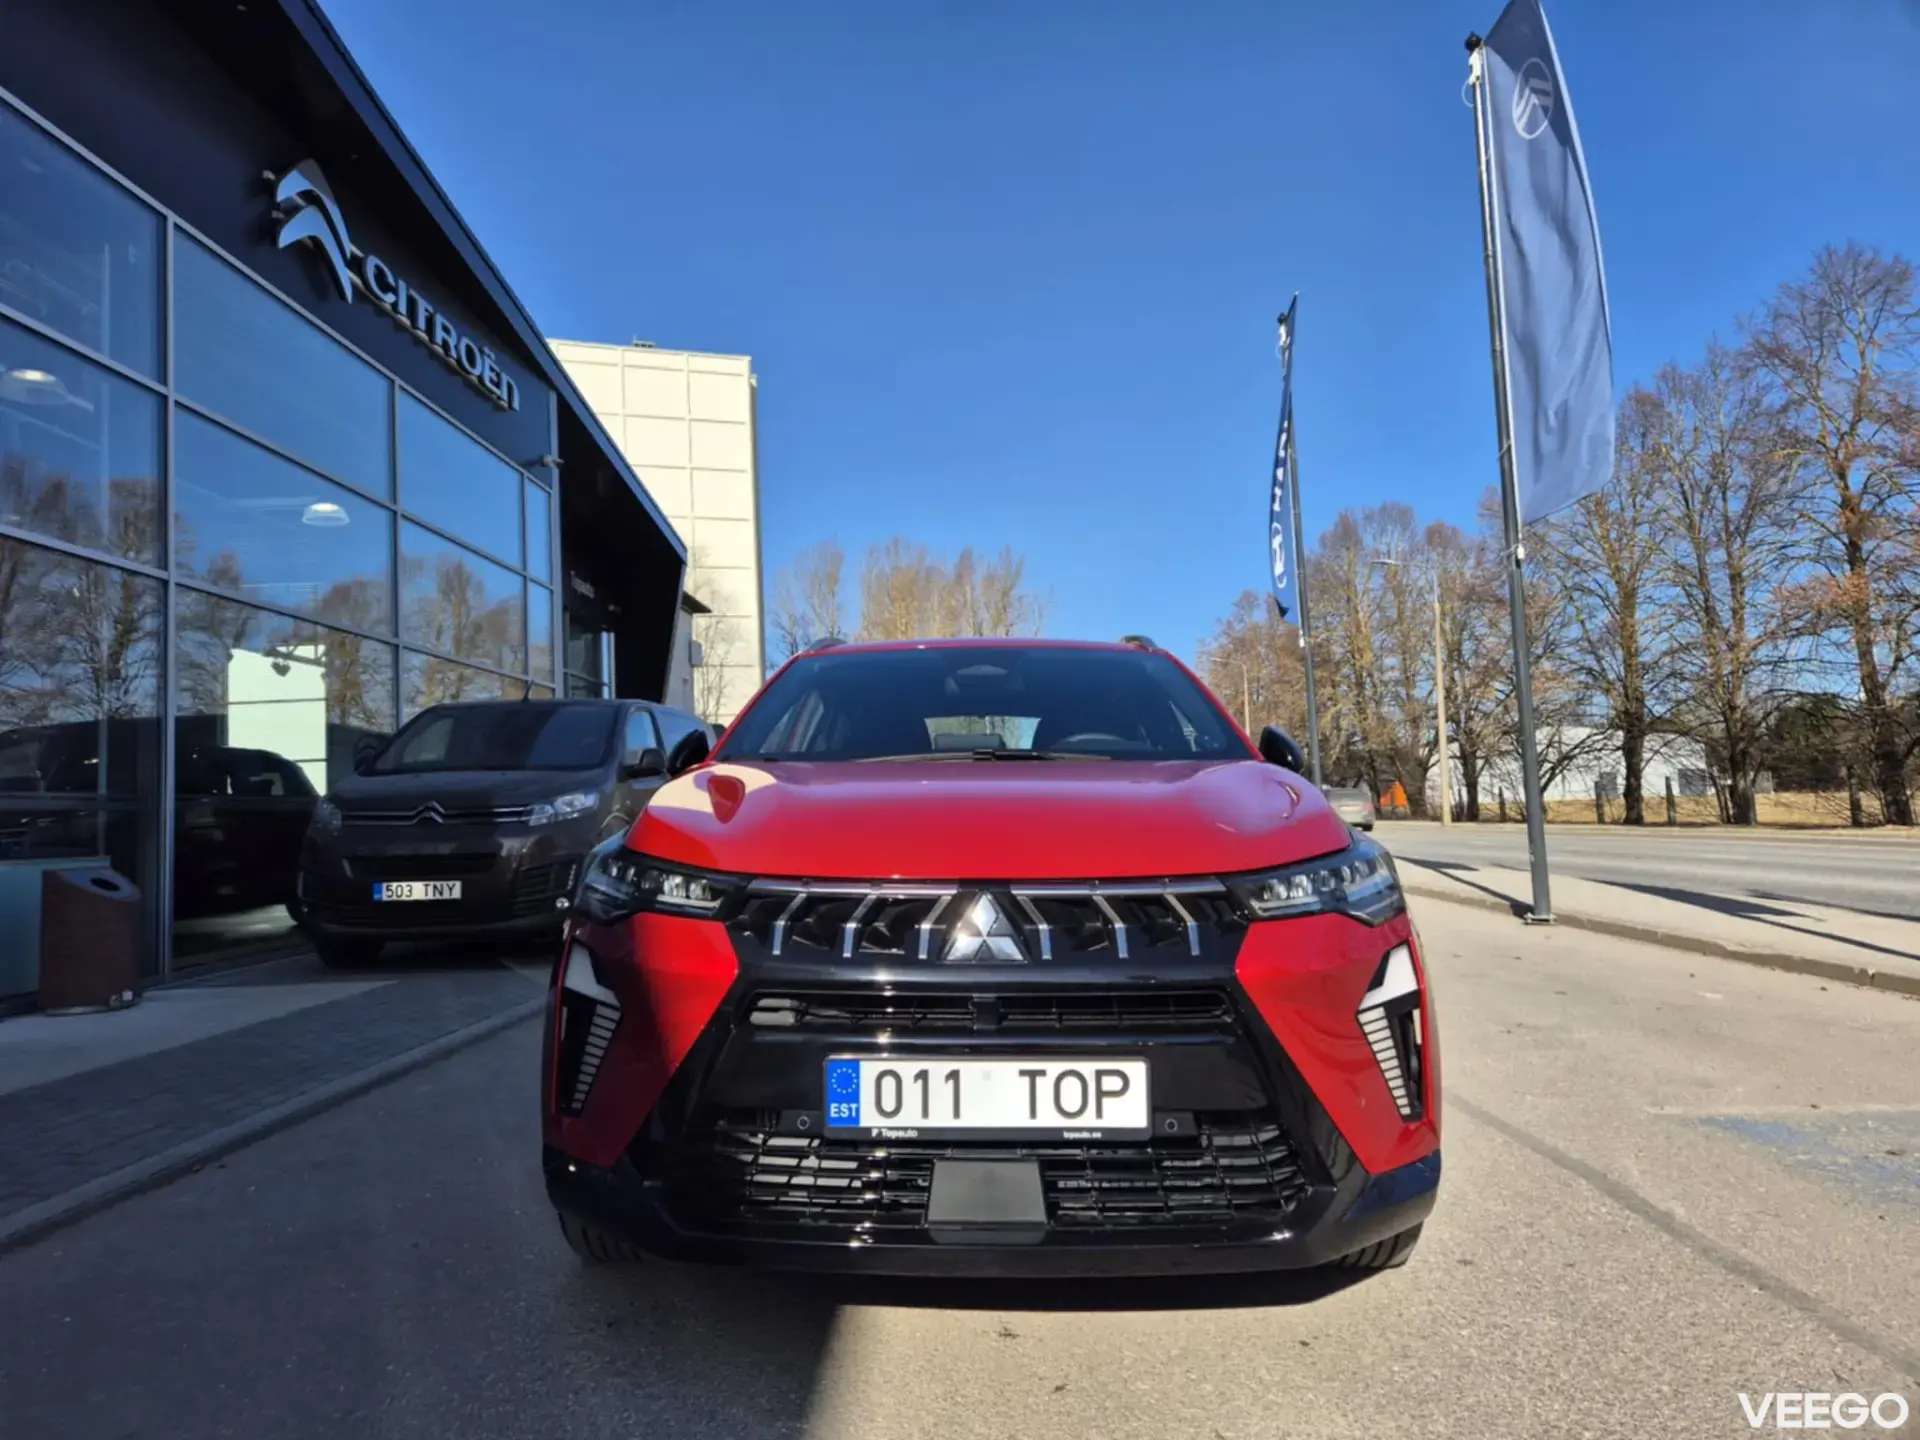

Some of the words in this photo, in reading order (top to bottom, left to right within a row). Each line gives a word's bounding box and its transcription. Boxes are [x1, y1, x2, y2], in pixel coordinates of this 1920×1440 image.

[385, 884, 413, 899] 503
[422, 882, 457, 898] TNY
[874, 1069, 961, 1119] 011
[1018, 1069, 1130, 1120] TOP
[830, 1102, 859, 1118] EST
